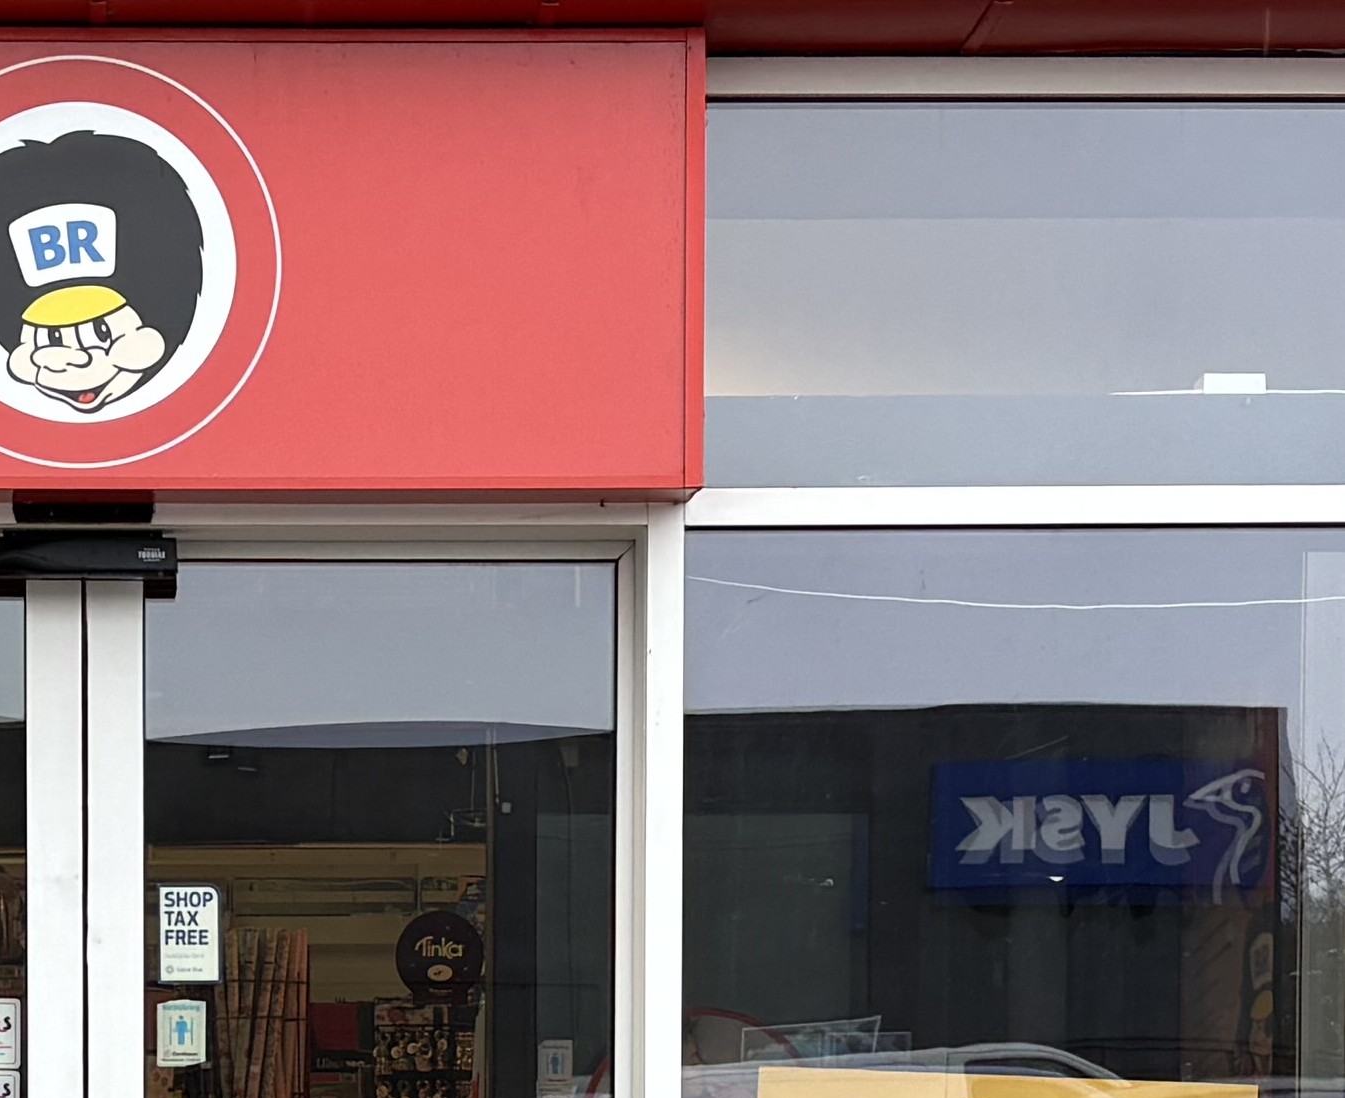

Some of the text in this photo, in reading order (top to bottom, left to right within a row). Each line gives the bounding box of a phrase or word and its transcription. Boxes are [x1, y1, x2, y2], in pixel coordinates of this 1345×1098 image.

[28, 220, 105, 270] BR
[164, 892, 214, 908] SHOP
[164, 911, 199, 927] TAX
[164, 930, 209, 945] FREE
[415, 936, 463, 959] Tinka
